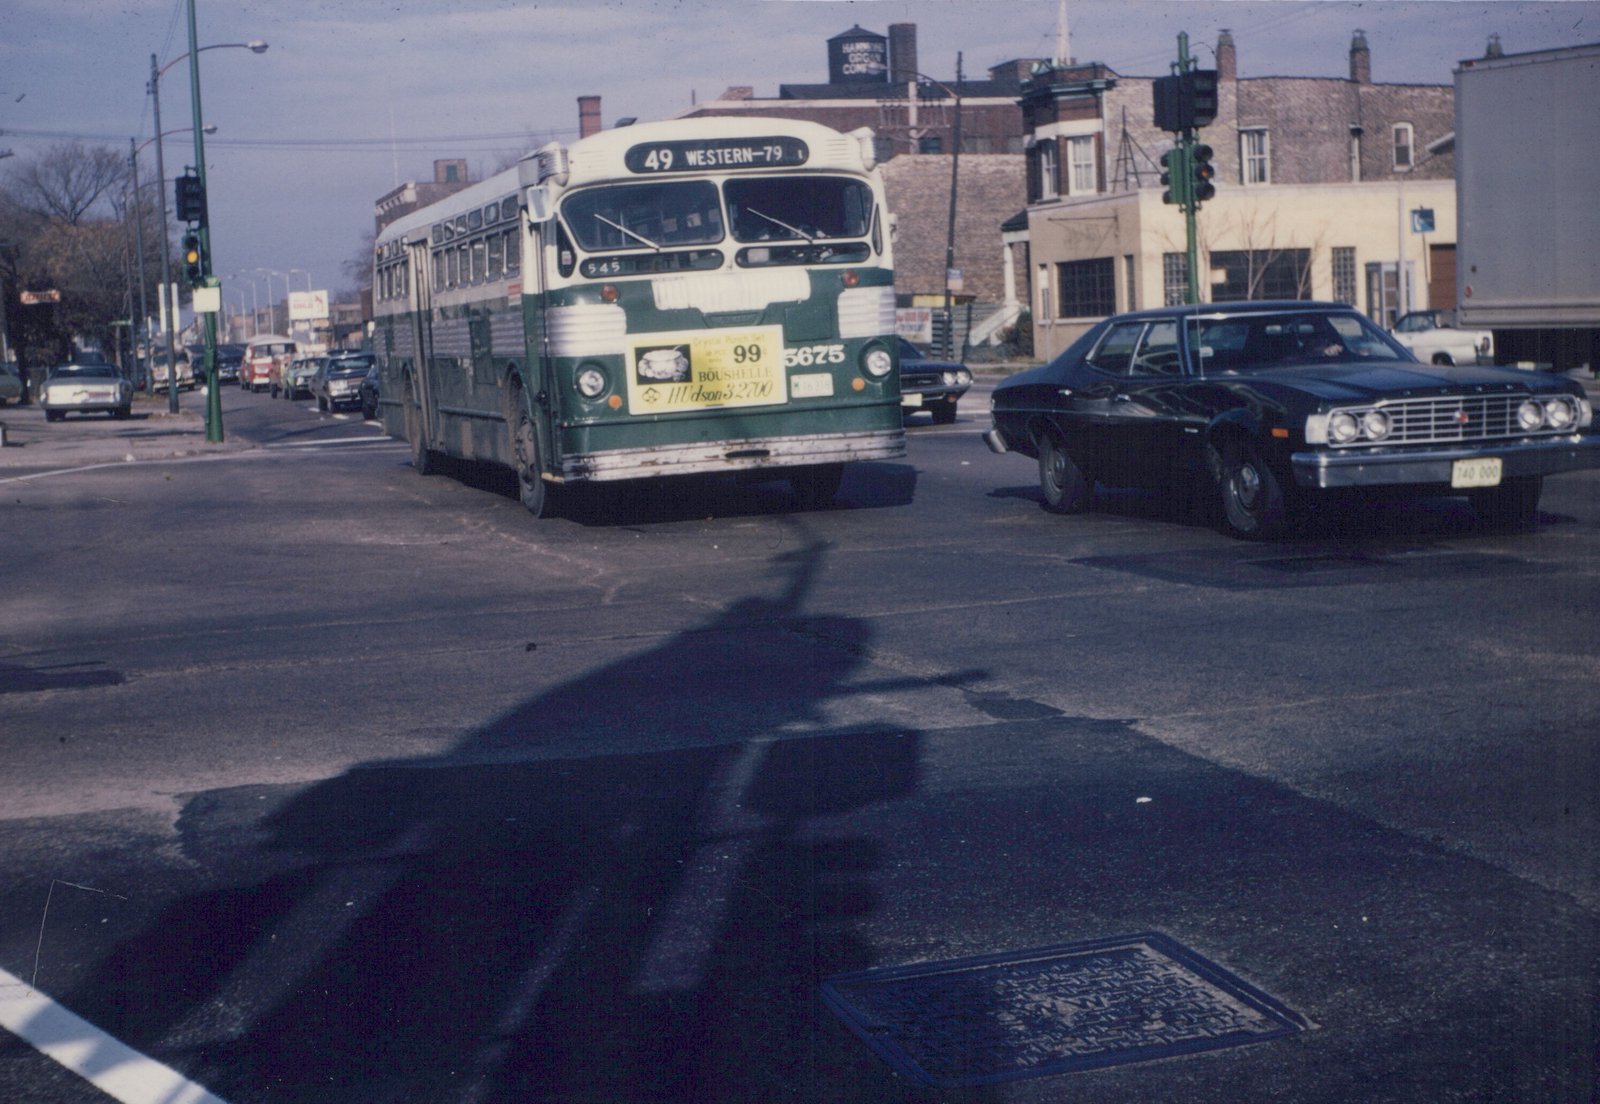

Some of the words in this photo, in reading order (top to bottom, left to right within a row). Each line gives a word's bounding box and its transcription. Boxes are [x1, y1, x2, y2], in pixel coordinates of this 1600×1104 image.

[848, 53, 881, 63] ORGAN
[645, 149, 673, 170] 49
[784, 344, 845, 367] 5675
[698, 366, 772, 383] BOUSHELLE
